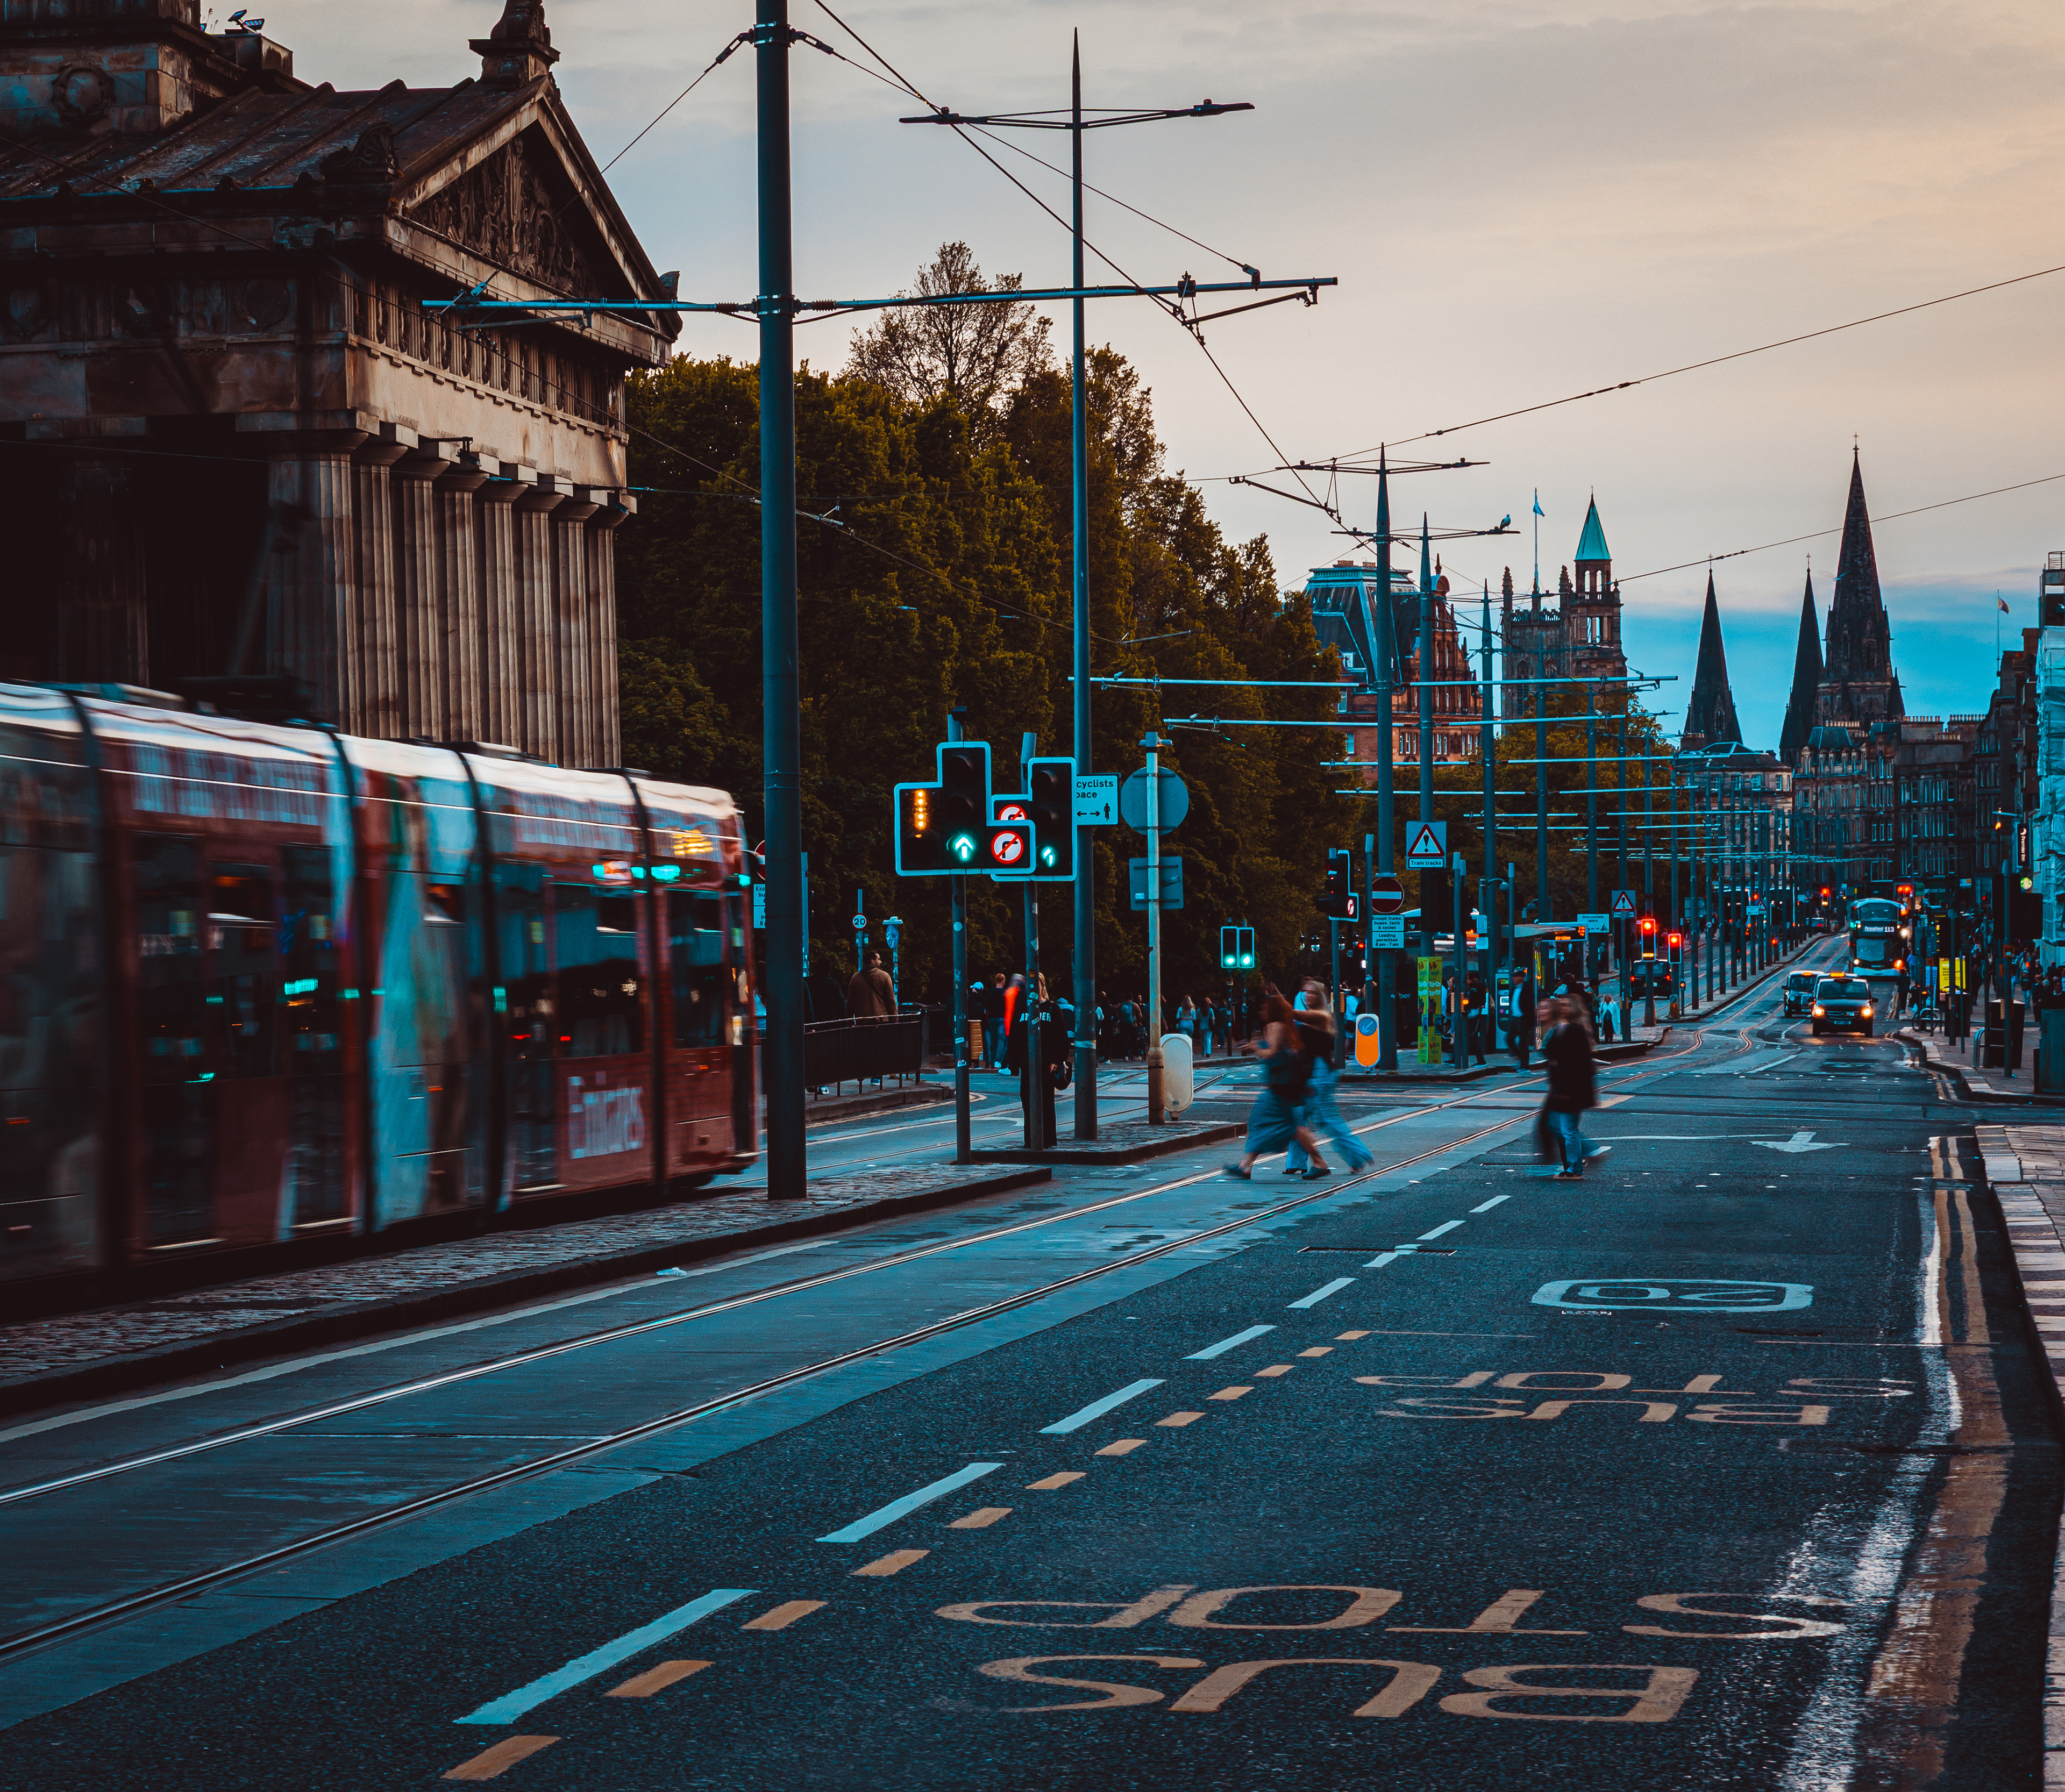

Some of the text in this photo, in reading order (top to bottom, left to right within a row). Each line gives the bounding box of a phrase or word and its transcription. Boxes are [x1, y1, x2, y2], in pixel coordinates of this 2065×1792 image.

[1076, 779, 1114, 789] cyclists
[1578, 1287, 1776, 1302] 20
[1352, 1371, 1914, 1397] STOP
[1376, 1398, 1831, 1425] BUS
[934, 1584, 1850, 1639] STOP
[977, 1654, 1700, 1722] BUS
